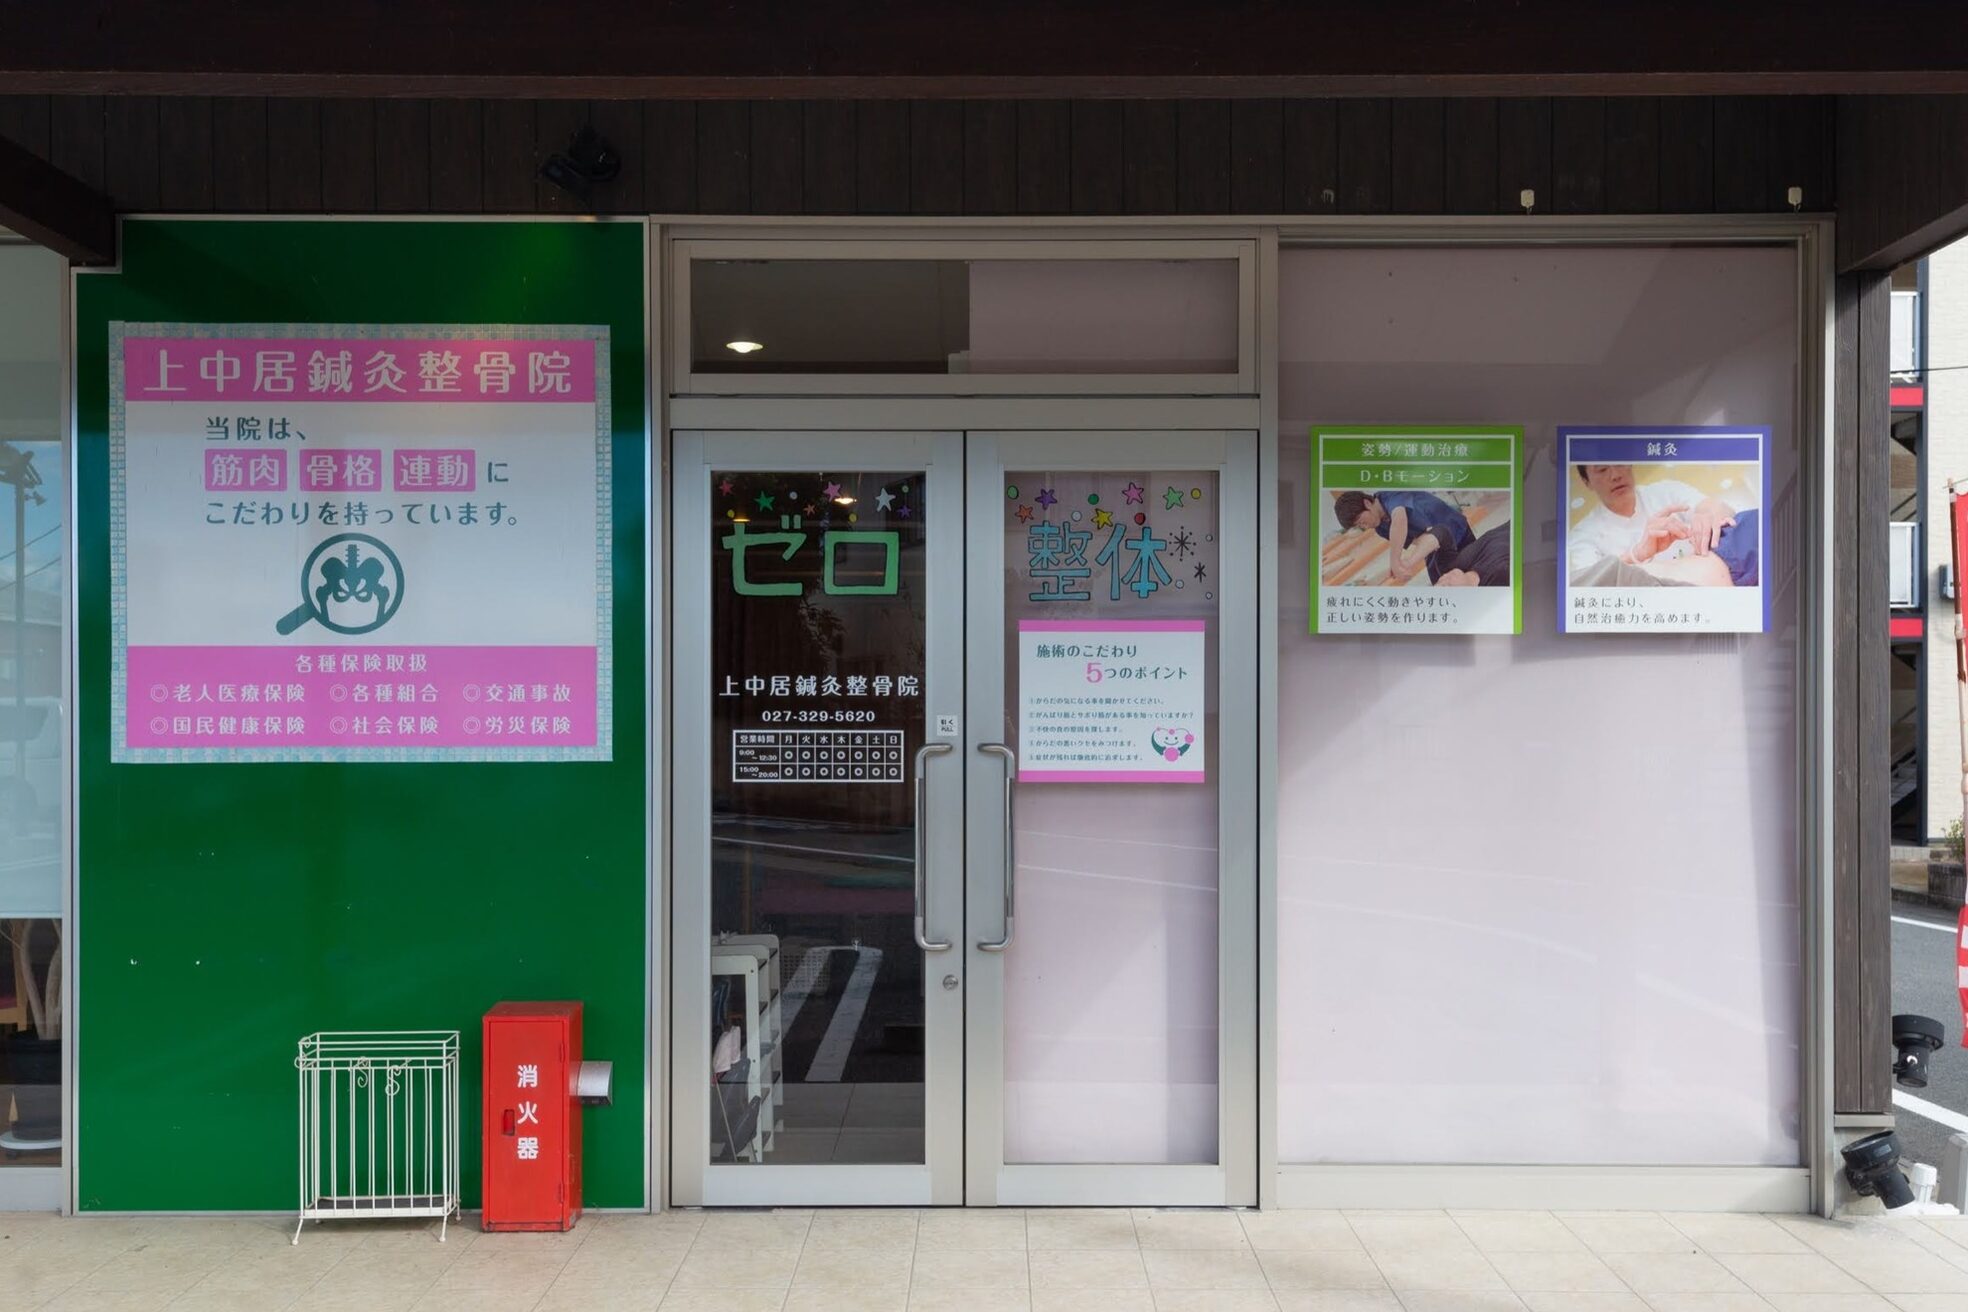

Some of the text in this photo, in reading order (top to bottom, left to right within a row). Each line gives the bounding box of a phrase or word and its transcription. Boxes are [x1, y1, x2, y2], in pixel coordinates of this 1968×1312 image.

[143, 349, 573, 394] 上中居鍼灸整骨院
[204, 414, 309, 443] 当院は、
[1646, 441, 1680, 457] 鍼灸
[209, 452, 282, 489] 筋肉
[305, 452, 378, 489] 骨格
[484, 458, 512, 485] に
[1359, 469, 1471, 484] D・Bモーション
[204, 500, 520, 527] こだわりを持っています。
[720, 512, 901, 597] ゼロ
[1026, 519, 1174, 603] 整体
[1325, 595, 1459, 609] 疲れにくく動きやすい、
[1573, 596, 1646, 609] 鍼灸により、
[1325, 611, 1460, 625] 正しい姿勢を作ります。
[1573, 612, 1713, 625] 自然治癒力を高めます。
[1036, 644, 1137, 658] 施術のこだわり
[293, 652, 430, 674] 各種保険取扱
[1085, 662, 1188, 683] 5つのポイント
[171, 682, 573, 704] 老人医療保険 各種組合 交通事故
[718, 675, 920, 697] 上中居鍼灸整骨院
[171, 714, 573, 736] 国民健康保険 社会保険 労災保険
[760, 709, 877, 724] 027-329-5620
[739, 733, 899, 745] 営業時間 月 火 水 木 金 土 日
[517, 1064, 539, 1160] 消火器
